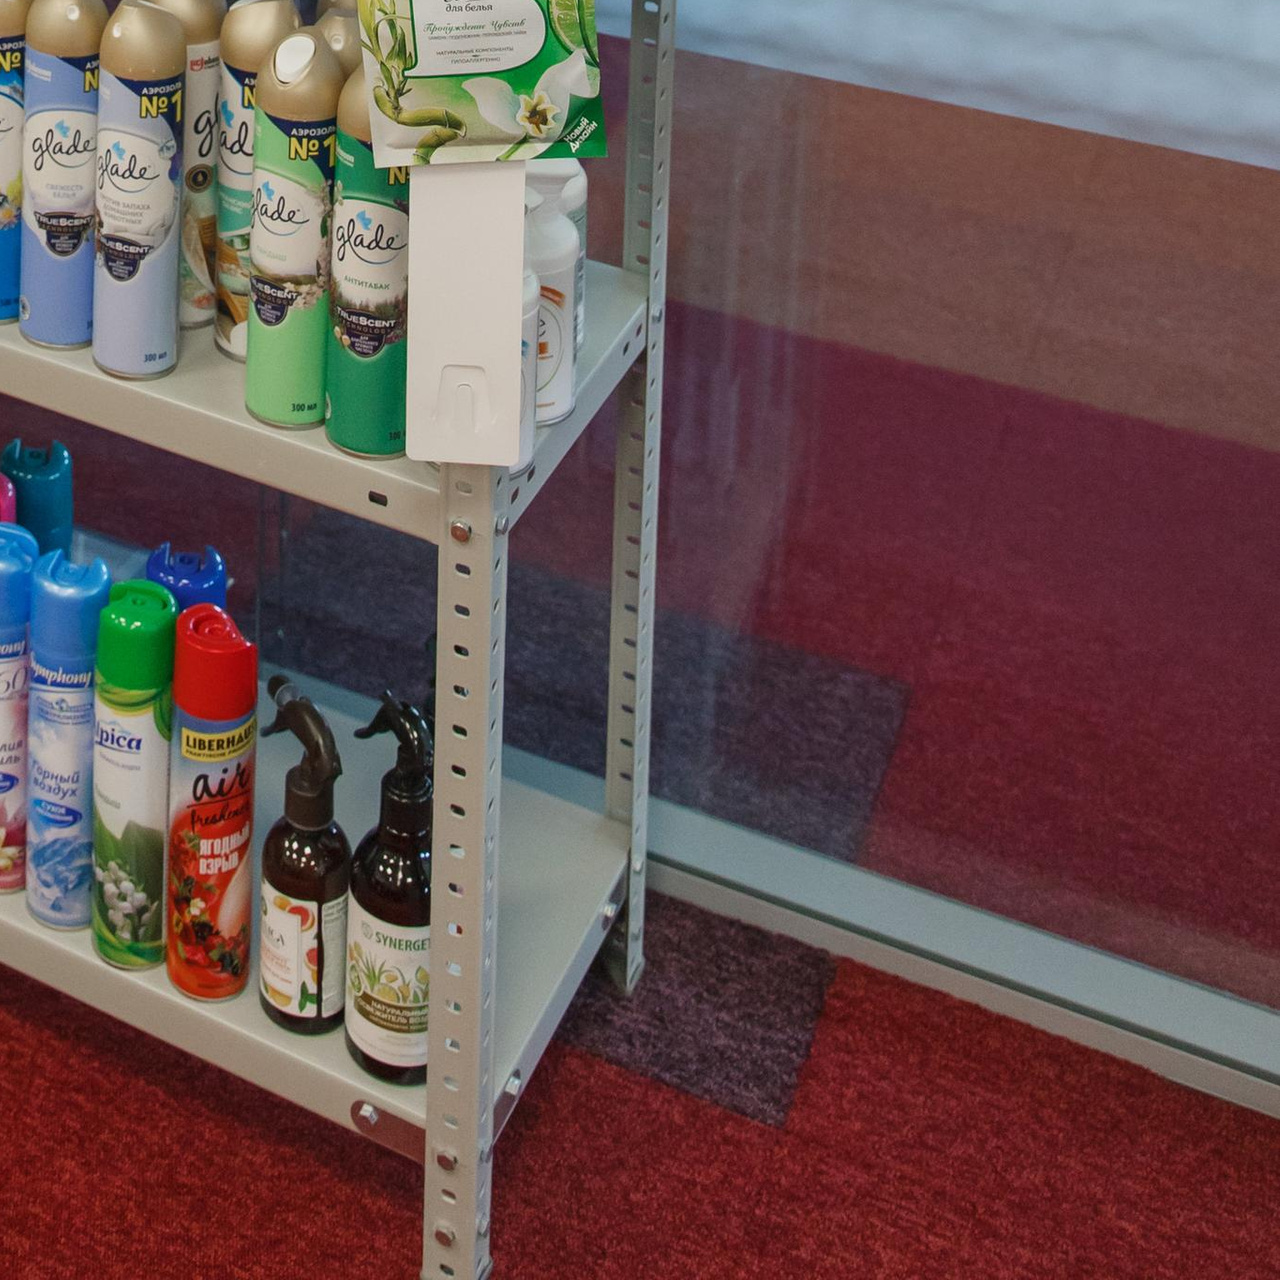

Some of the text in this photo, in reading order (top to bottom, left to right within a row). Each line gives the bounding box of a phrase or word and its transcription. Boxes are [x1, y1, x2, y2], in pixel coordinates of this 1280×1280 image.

[445, 3, 493, 13] для белья
[475, 46, 514, 54] КОМПОНЕНТЫ
[171, 90, 183, 123] 1
[32, 129, 97, 171] glade
[322, 135, 337, 168] 1
[98, 148, 161, 190] glade
[44, 183, 84, 192] СВЕЖЕСТЬ
[52, 191, 76, 199] БЕЛЬЯ
[122, 202, 151, 211] ЗАПАХА
[336, 218, 407, 261] glade
[344, 274, 390, 290] АНТИТАБАК
[337, 306, 396, 328] TRUESCENT
[143, 351, 168, 363] 300 мл
[291, 402, 317, 413] 300 мл
[97, 721, 143, 752] lpica
[31, 760, 80, 784] Горный
[192, 762, 250, 802] air
[33, 776, 78, 800] воздух
[40, 802, 66, 815] СУХОЕ
[199, 822, 250, 856] ЯГОДНЫЙ
[199, 852, 239, 875] ВЗРЫВ
